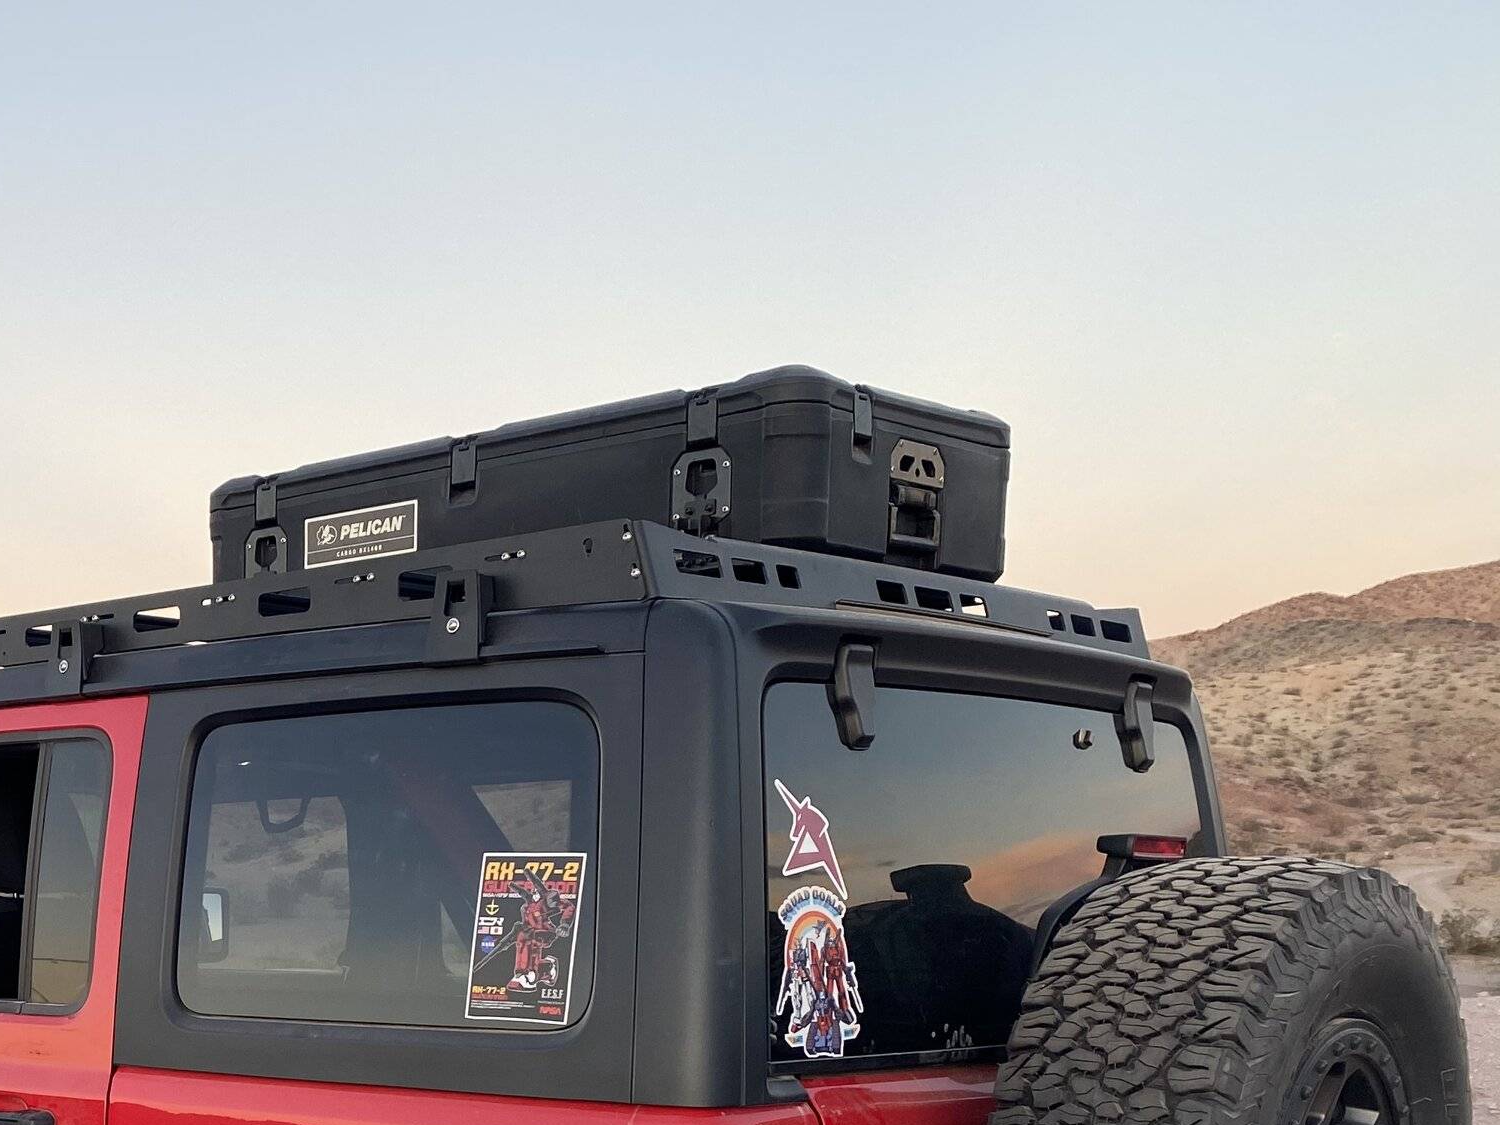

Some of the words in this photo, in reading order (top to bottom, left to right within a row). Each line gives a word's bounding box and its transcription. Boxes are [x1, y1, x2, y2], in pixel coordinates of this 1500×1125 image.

[485, 861, 580, 882] RX-77-2
[780, 889, 810, 921] SQUAD
[812, 889, 844, 916] GOALS
